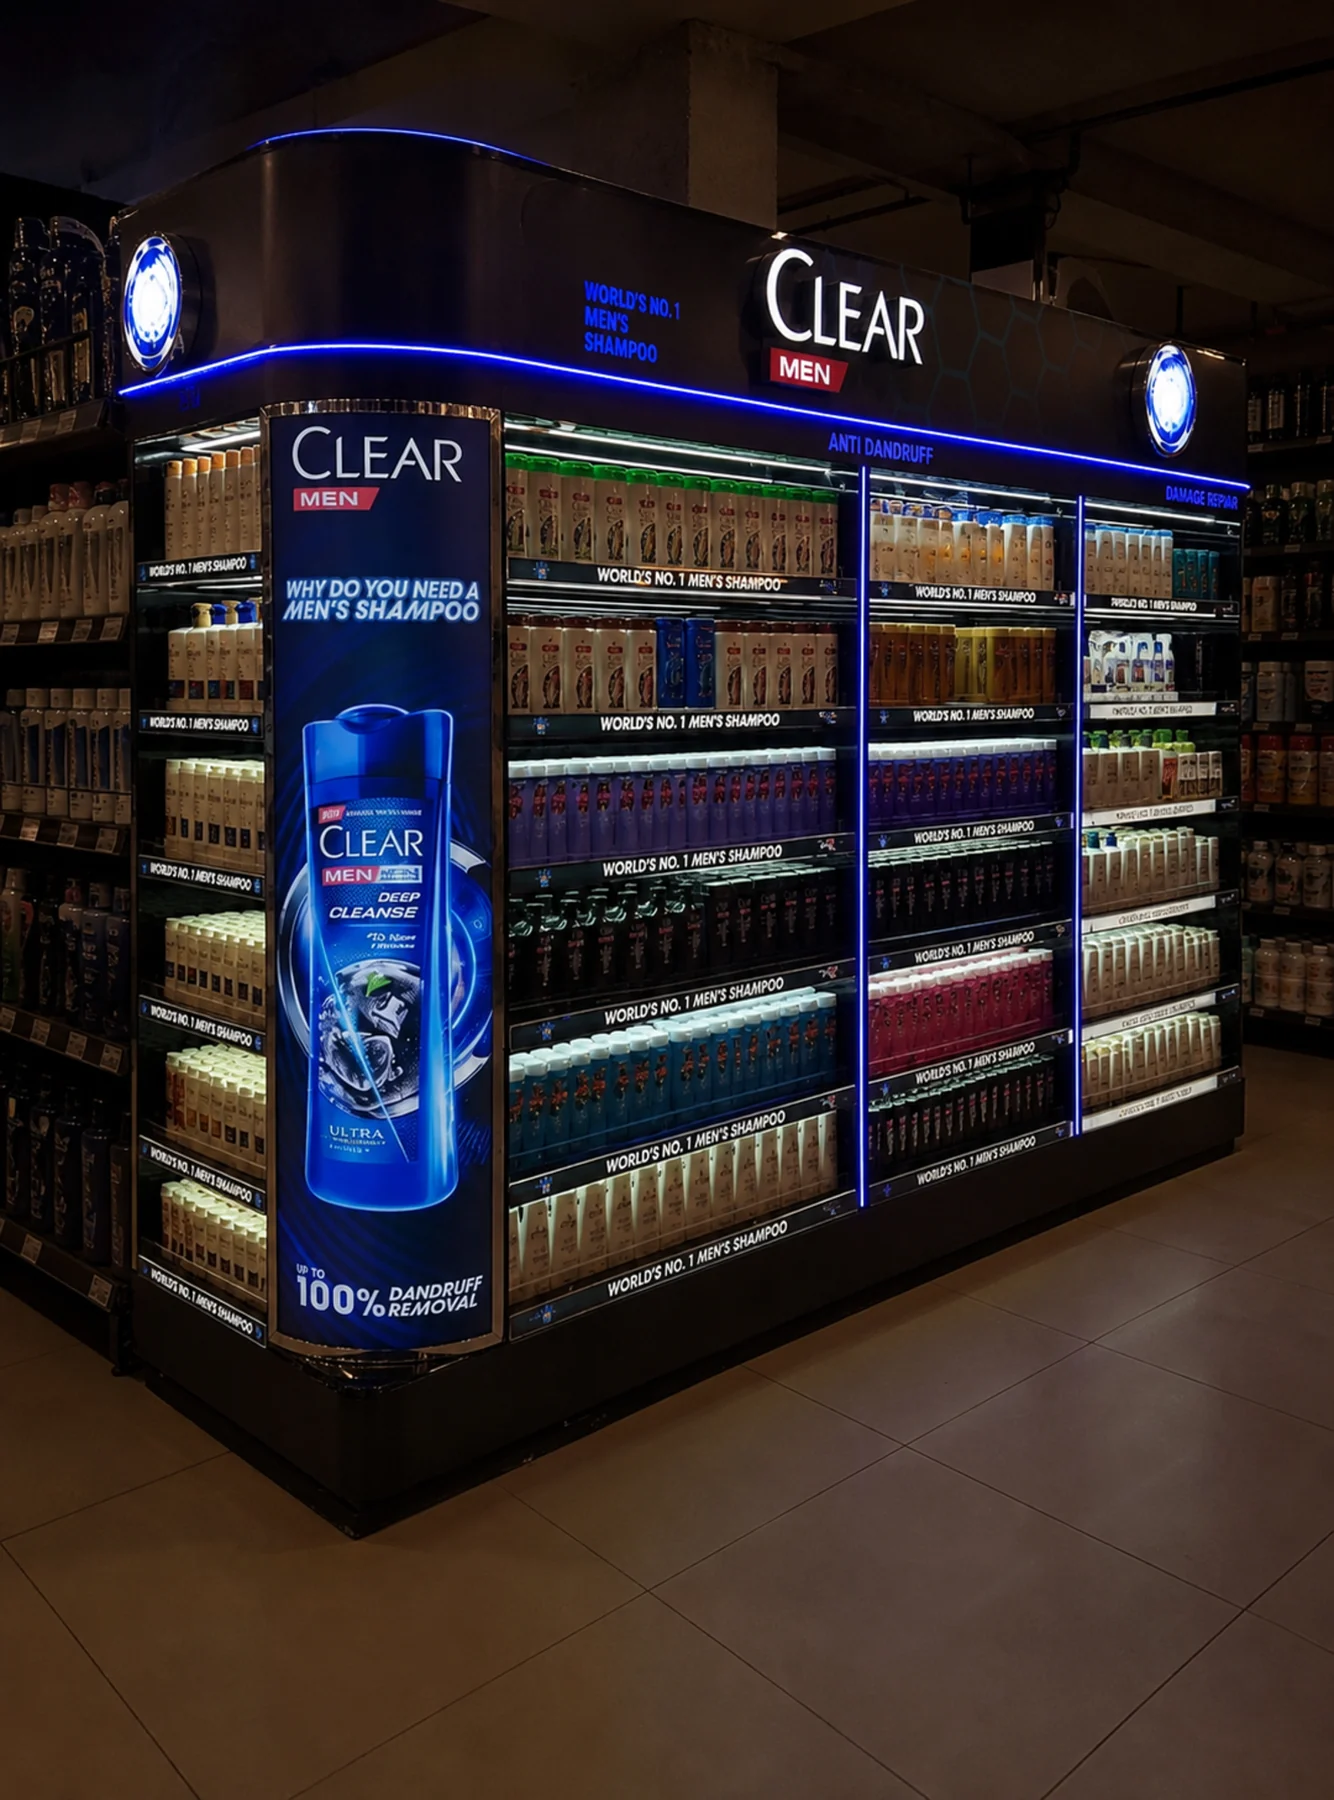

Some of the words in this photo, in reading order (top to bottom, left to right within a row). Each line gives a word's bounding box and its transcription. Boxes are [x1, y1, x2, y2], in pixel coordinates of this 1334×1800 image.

[584, 280, 646, 313] WORLD'S
[650, 297, 671, 318] NO.
[674, 302, 680, 320] 1
[766, 248, 925, 365] CLEAR
[584, 306, 629, 334] MEN'S
[584, 332, 658, 363] SHAMPOO
[779, 355, 830, 385] MEN
[292, 426, 463, 482] CLEAR
[828, 432, 860, 454] ANTI
[865, 438, 933, 465] DANDRUFF
[300, 491, 358, 507] MEN
[1166, 485, 1205, 506] DAMAGE
[286, 579, 327, 599] WHY
[329, 579, 360, 598] DO
[365, 579, 408, 599] YOU
[412, 580, 463, 600] NEED
[465, 581, 479, 600] A
[598, 568, 651, 584] WORLD'S
[655, 569, 676, 585] NO.
[688, 574, 723, 588] MEN'S
[726, 576, 781, 591] SHAMPOO
[916, 586, 951, 598] WORLD'S
[282, 599, 349, 620] MEN'S
[355, 600, 479, 621] SHAMPOO
[601, 716, 653, 730] WORLD'S
[657, 716, 677, 729] NO.
[689, 715, 723, 728] MEN'S
[725, 713, 780, 727] SHAMPOO
[914, 710, 949, 721] WORLD'S
[319, 825, 423, 859] CLEAR
[914, 829, 950, 843] WORLD'S
[603, 858, 656, 876] WORLD'S
[659, 857, 681, 872] NO.
[691, 851, 727, 869] MEN'S
[728, 845, 783, 864] SHAMPOO
[325, 868, 372, 882] MEN
[378, 892, 421, 903] DEEP
[329, 906, 419, 919] CLEANSE
[915, 947, 950, 962] WORLD'S
[605, 1002, 657, 1024] WORLD'S
[661, 999, 681, 1014] NO.
[693, 989, 727, 1011] MEN'S
[729, 977, 785, 1000] SHAMPOO
[916, 1065, 951, 1084] WORLD'S
[329, 1124, 384, 1139] ULTRA
[606, 1145, 660, 1173] WORLD'S
[662, 1139, 684, 1161] NO.
[695, 1127, 730, 1147] MEN'S
[731, 1110, 786, 1138] SHAMPOO
[917, 1164, 952, 1185] WORLD'S
[608, 1265, 661, 1296] WORLD'S
[665, 1259, 685, 1276] NO.
[697, 1241, 730, 1264] MEN'S
[733, 1221, 787, 1251] SHAMPOO
[296, 1263, 308, 1274] UP
[311, 1267, 325, 1279] TO
[297, 1276, 386, 1317] 100%
[389, 1275, 483, 1301] DANDRUFF
[388, 1293, 477, 1317] REMOVAL
